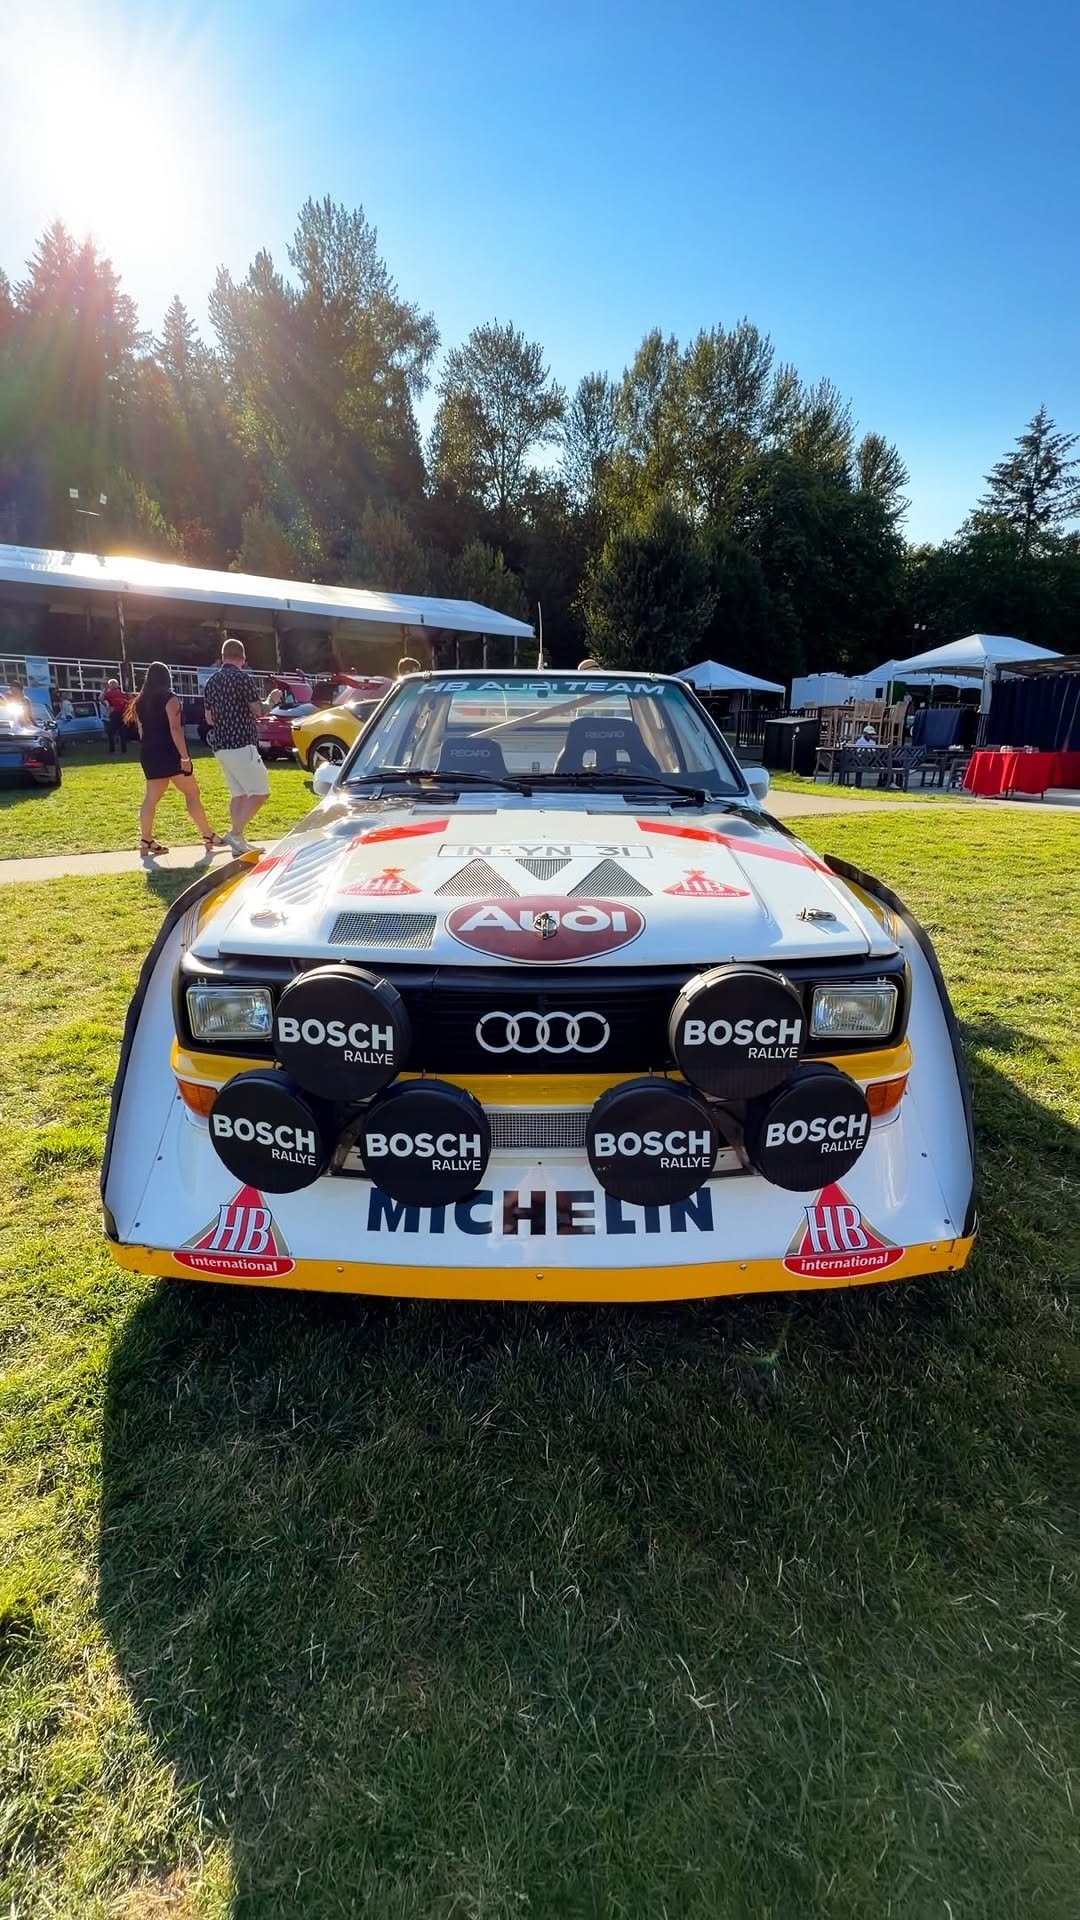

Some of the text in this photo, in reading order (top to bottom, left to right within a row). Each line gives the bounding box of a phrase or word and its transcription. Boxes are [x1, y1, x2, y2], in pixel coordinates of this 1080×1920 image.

[417, 681, 470, 694] HB
[565, 682, 666, 695] TEAM
[584, 731, 626, 740] RECARO
[449, 749, 490, 758] RECARO
[681, 879, 725, 891] HB
[278, 1017, 394, 1051] BOSCH
[683, 1019, 802, 1047] BOSCH
[344, 1049, 394, 1066] RALLYE
[748, 1046, 798, 1060] RALLYE
[212, 1113, 316, 1153] BOSCH
[765, 1113, 868, 1148] BOSCH
[366, 1132, 481, 1158] BOSCH
[594, 1129, 711, 1157] BOSCH
[820, 1138, 864, 1155] RALLYE
[271, 1148, 316, 1167] RALLYE
[431, 1158, 481, 1172] RALLYE
[660, 1156, 711, 1169] RALLYE
[367, 1187, 714, 1235] MICHELIN
[208, 1204, 272, 1253] HB
[804, 1204, 869, 1253] HB
[189, 1255, 278, 1272] international
[800, 1252, 889, 1271] international
